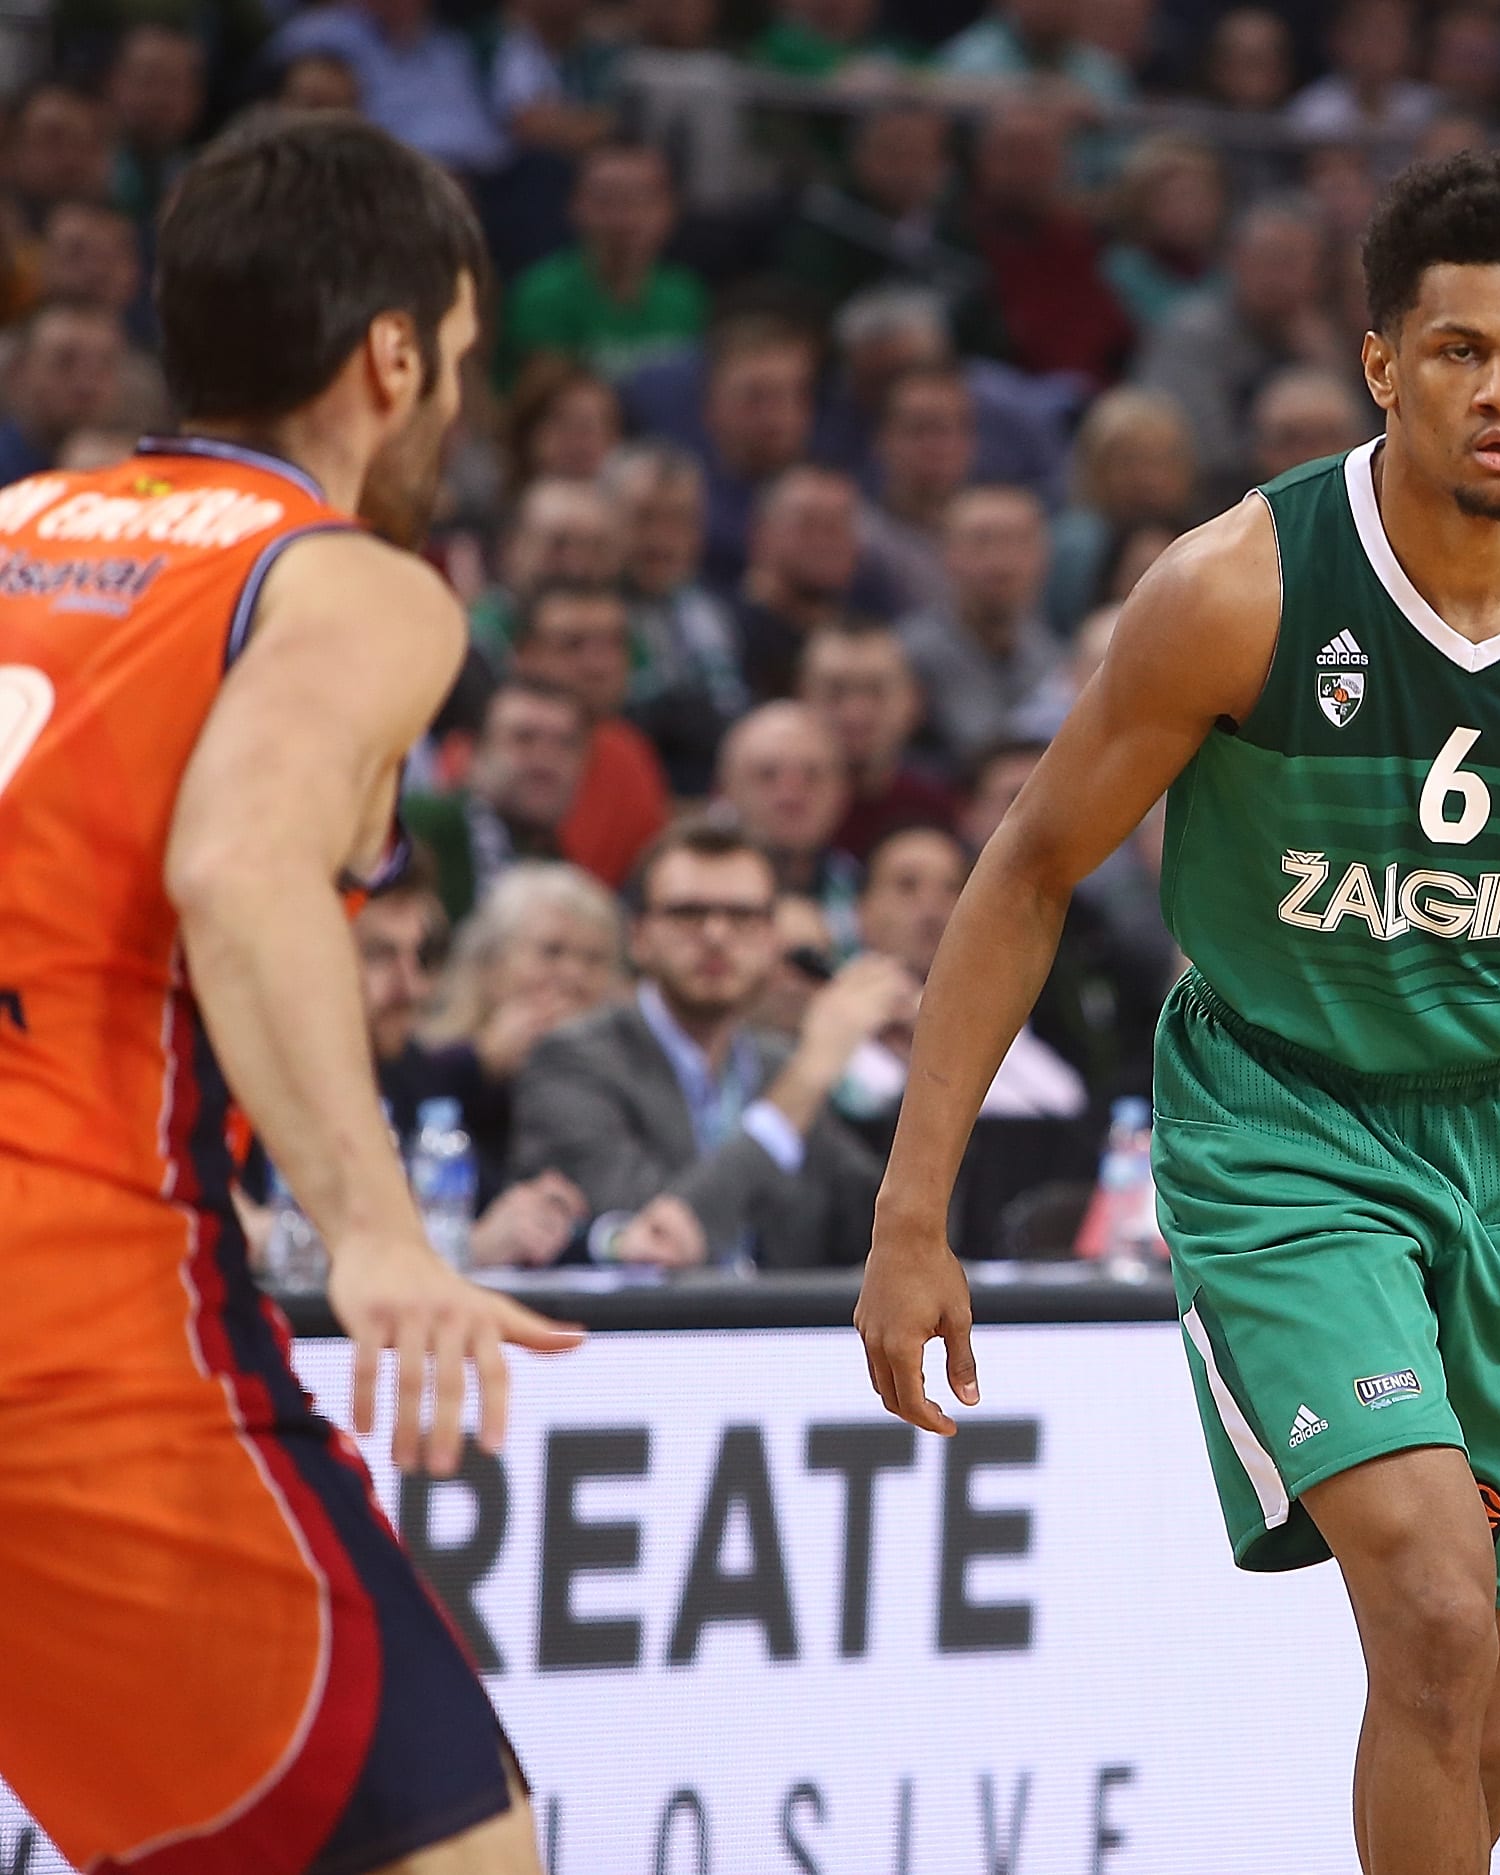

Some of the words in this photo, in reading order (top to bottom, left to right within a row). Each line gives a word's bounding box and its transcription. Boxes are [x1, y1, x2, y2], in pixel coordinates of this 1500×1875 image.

[1316, 652, 1369, 665] adidas
[1419, 726, 1491, 844] 6
[1359, 1371, 1417, 1399] UTENOS
[1288, 1418, 1329, 1448] adidas
